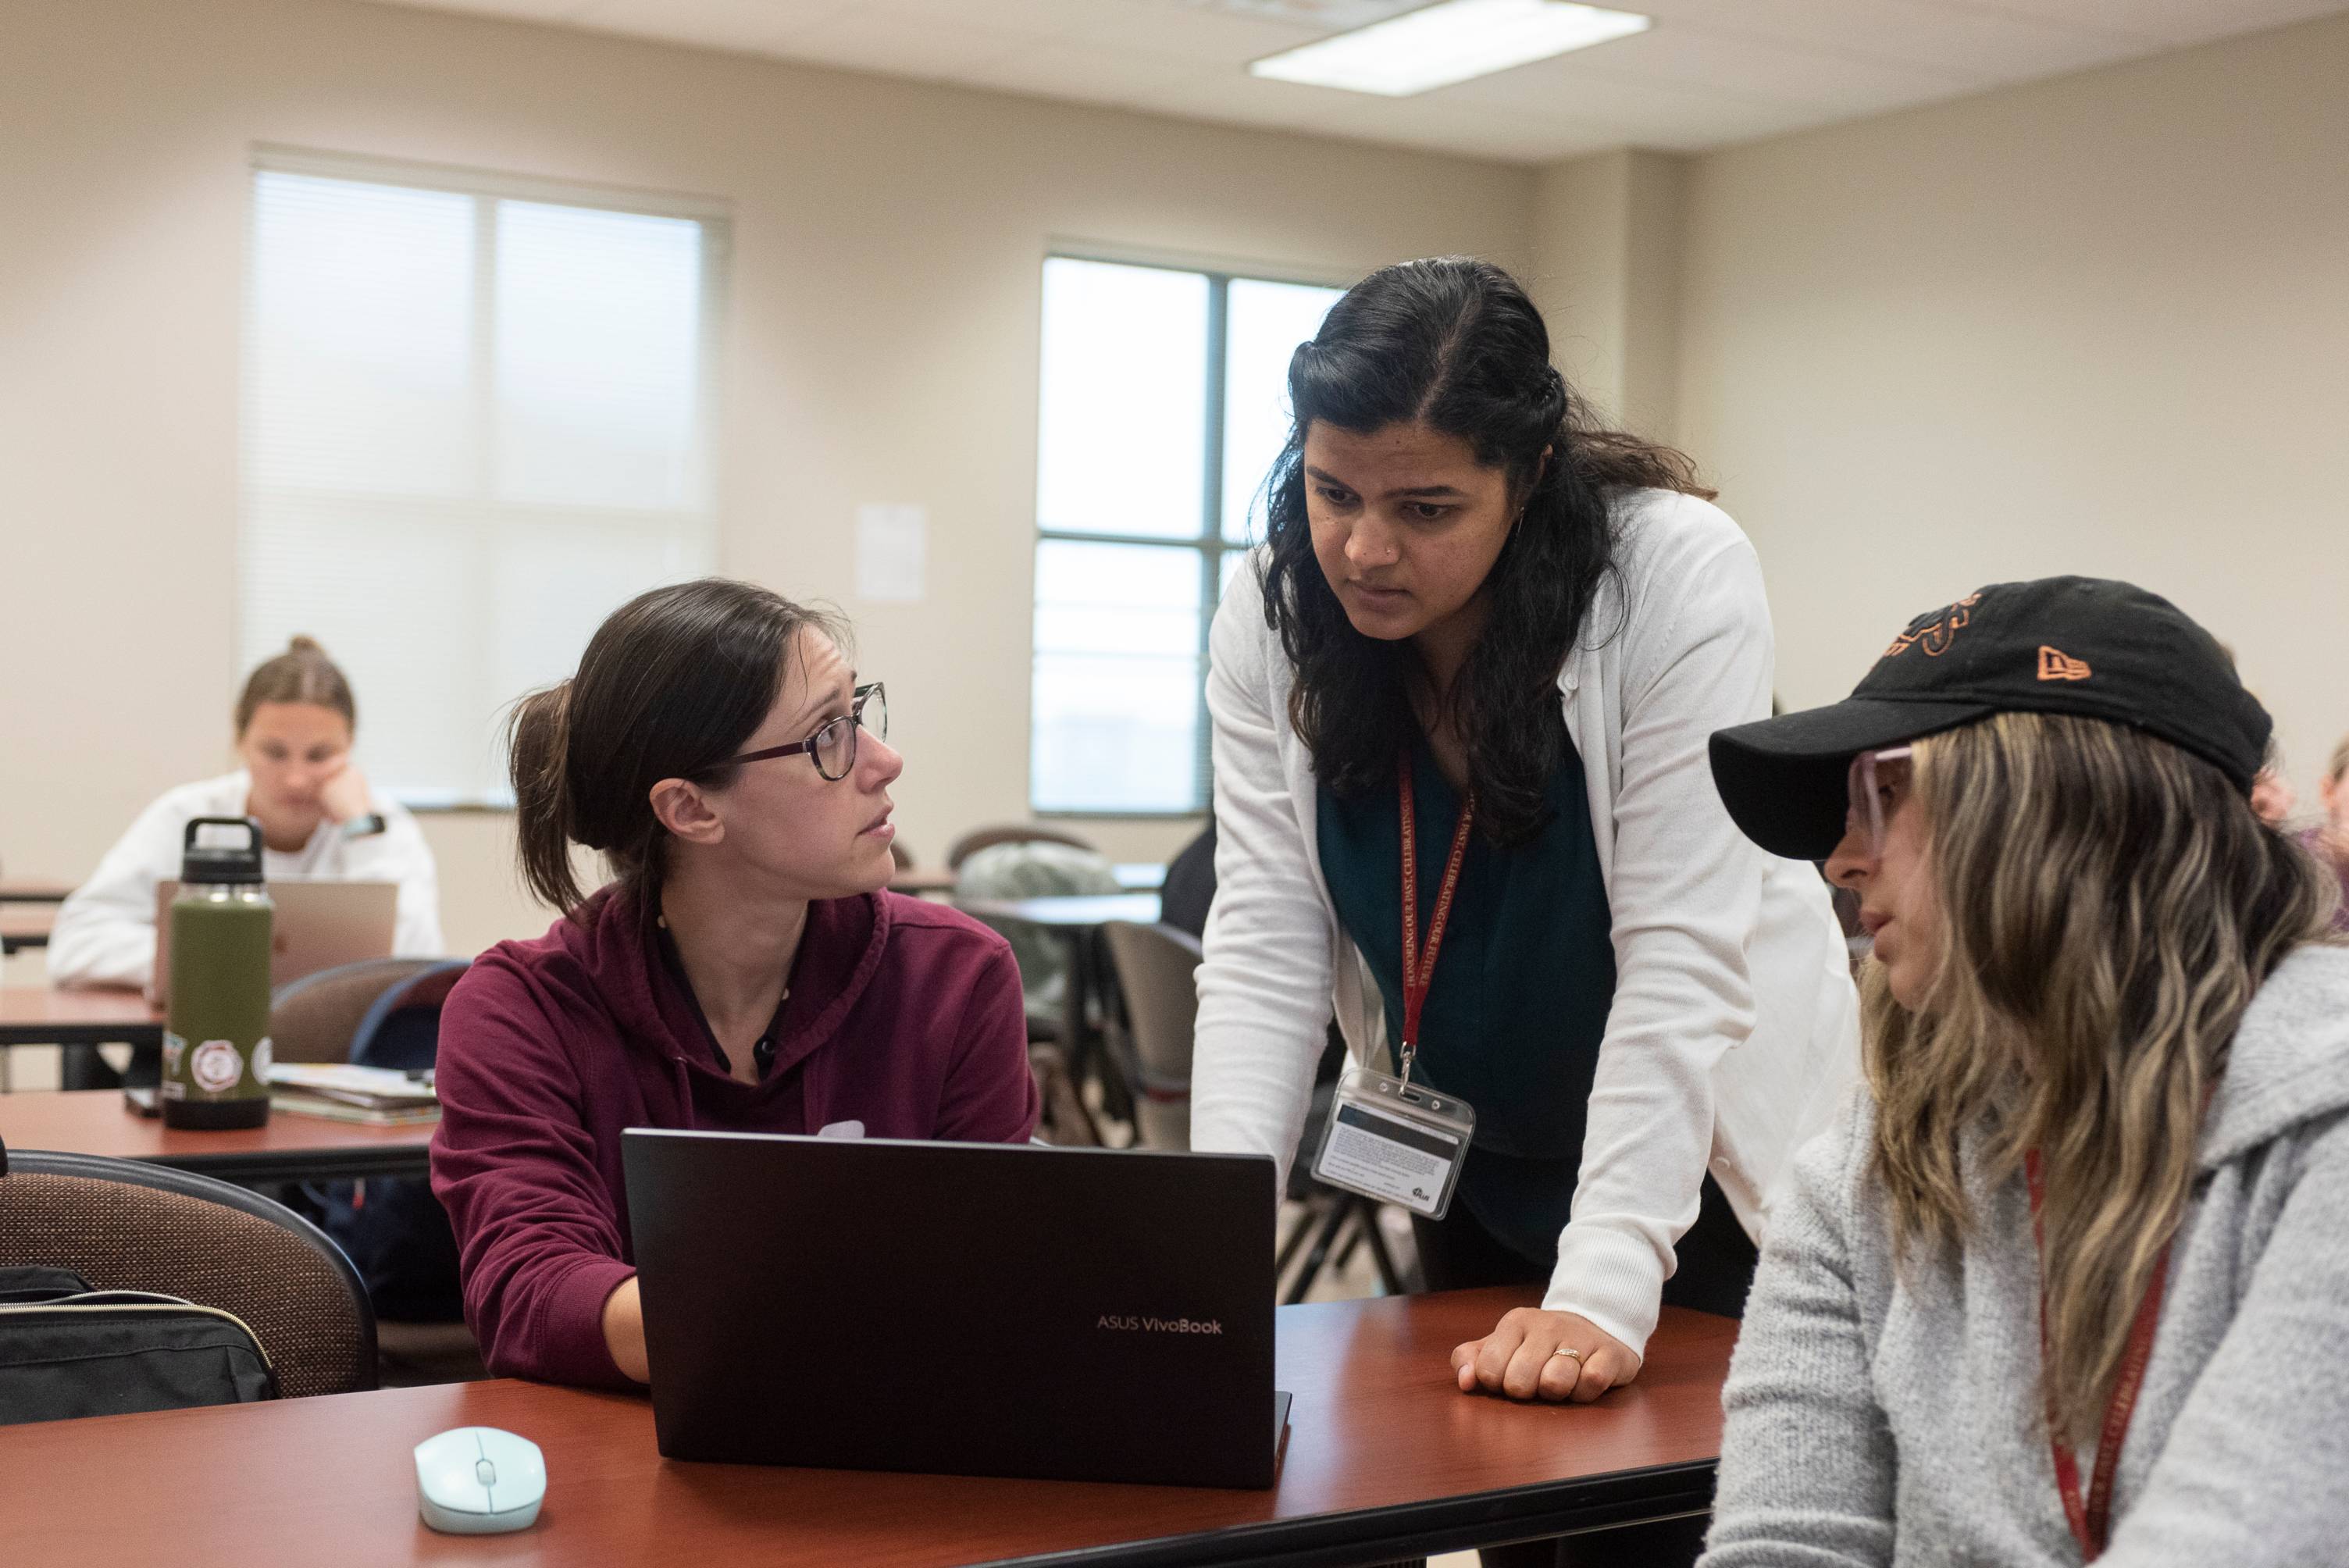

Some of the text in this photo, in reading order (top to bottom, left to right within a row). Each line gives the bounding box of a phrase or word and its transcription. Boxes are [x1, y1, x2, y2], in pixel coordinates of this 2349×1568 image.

[1403, 805, 1413, 875] CELEBRATING
[1455, 823, 1470, 849] PAST,
[1437, 850, 1462, 920] CELEBRATING
[1405, 903, 1413, 928] OUR
[1429, 921, 1443, 944] OUR
[1406, 928, 1415, 987] HONORING
[1419, 944, 1437, 986] FUTURE
[1097, 1316, 1222, 1335] ASUS VivoBook
